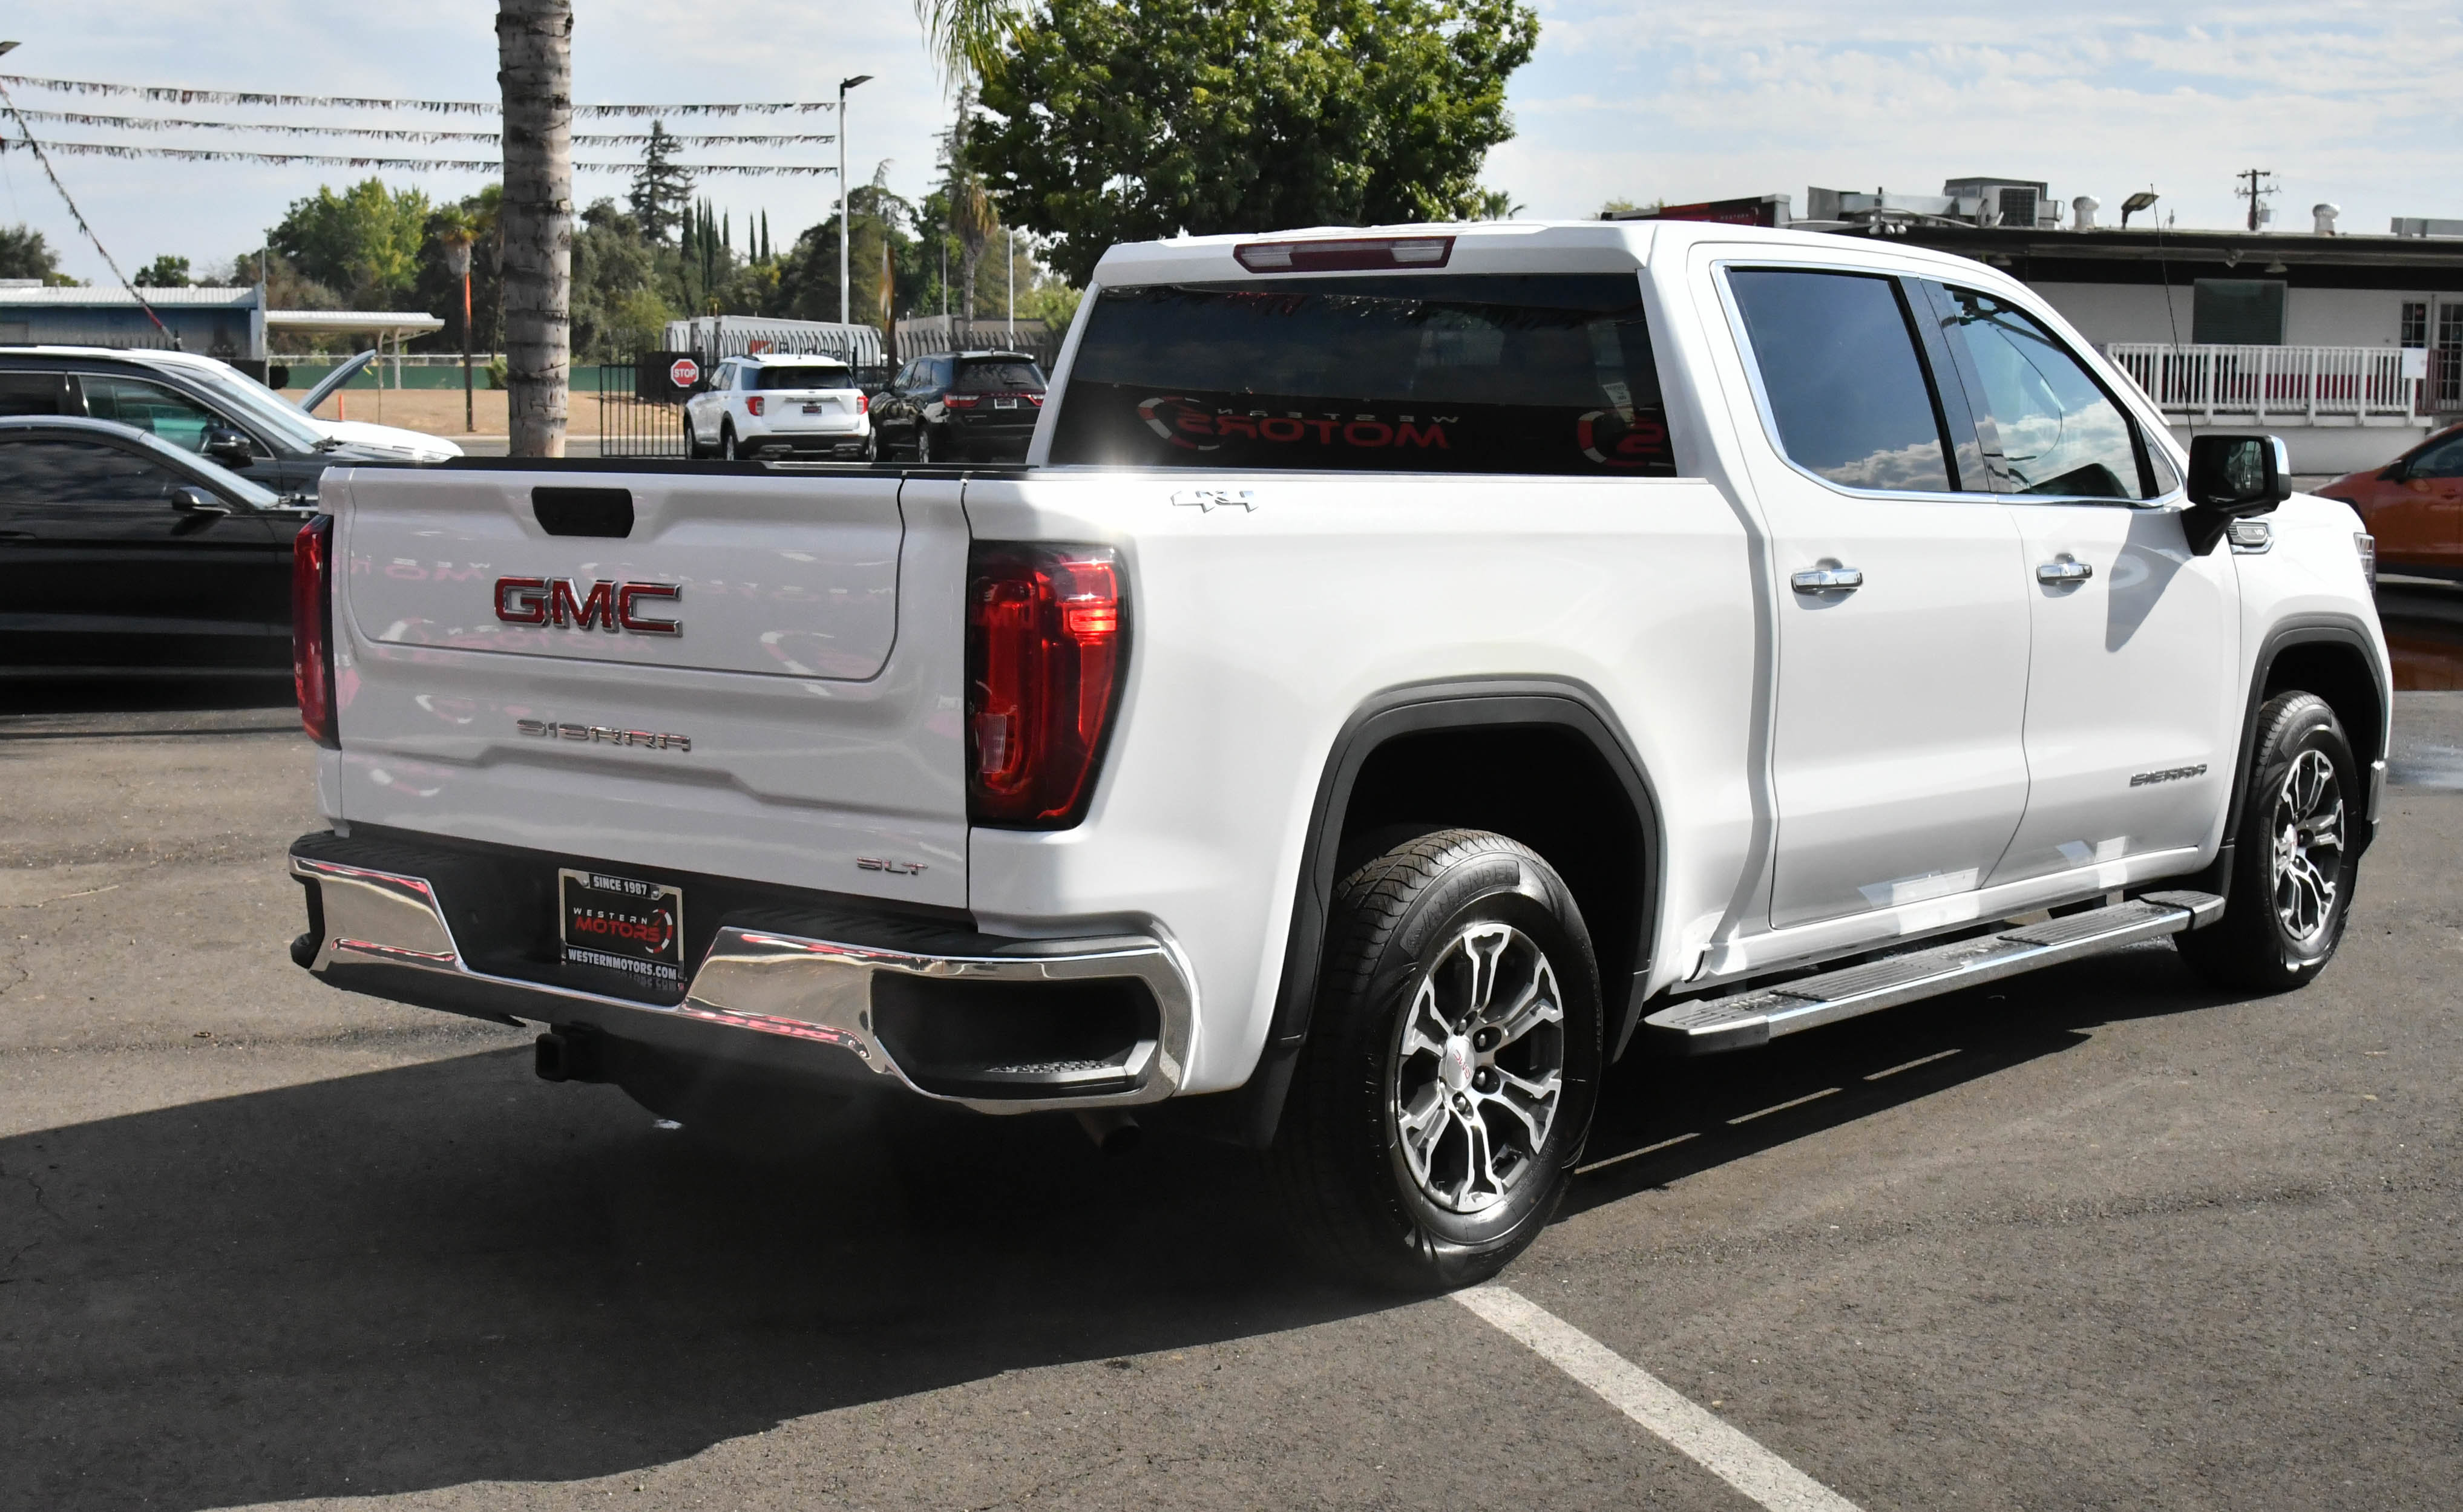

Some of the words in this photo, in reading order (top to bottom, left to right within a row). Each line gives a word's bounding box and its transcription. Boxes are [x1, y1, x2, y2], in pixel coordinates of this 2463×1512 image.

[674, 368, 696, 378] STOP
[494, 575, 683, 638] GMC
[516, 719, 692, 751] SIERRA
[2129, 763, 2208, 788] SIERRA
[856, 856, 928, 875] SLT
[593, 875, 621, 891] SINCE
[624, 881, 648, 895] 1987
[573, 907, 648, 925] WESTERN
[575, 915, 660, 943] MOTORS
[568, 948, 677, 981] WESTERNMOTORS.COM
[1453, 1049, 1471, 1080] GMC
